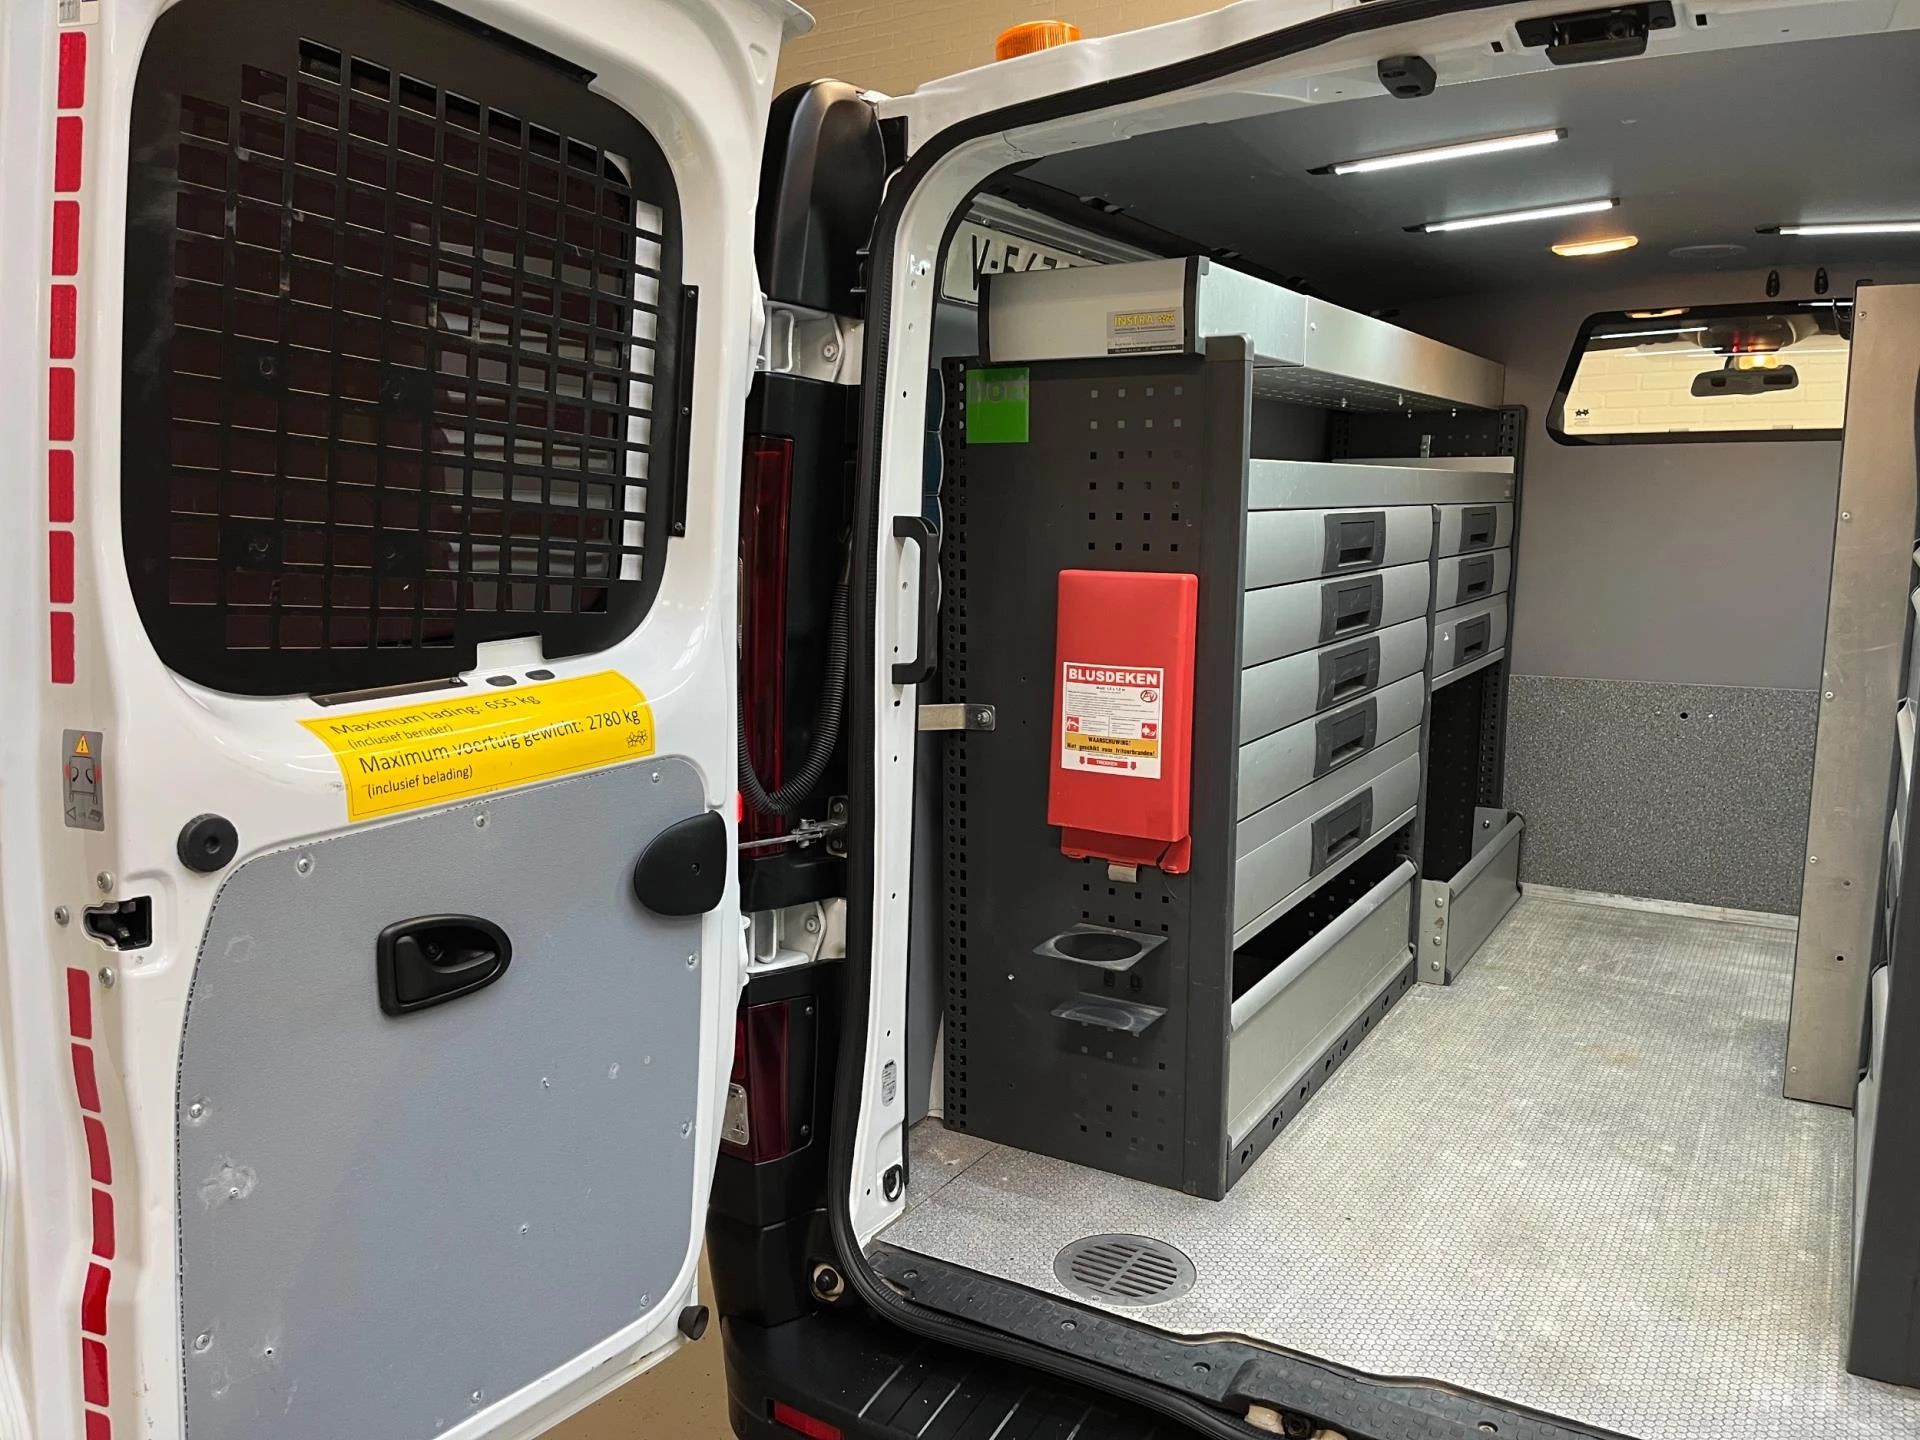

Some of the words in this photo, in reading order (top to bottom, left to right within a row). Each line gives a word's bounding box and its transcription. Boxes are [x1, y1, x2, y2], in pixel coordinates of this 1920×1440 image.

[1114, 314, 1153, 326] INSTRA
[1069, 668, 1157, 685] BLUSDEKEN
[330, 713, 422, 735] Maximum
[422, 704, 484, 721] lading:
[485, 697, 516, 710] 655
[516, 695, 541, 705] kg
[347, 731, 404, 750] (inclusief
[404, 724, 453, 739] berijder)
[359, 746, 450, 774] Maximum
[453, 731, 521, 757] voertuig
[524, 720, 584, 746] gewicht:
[586, 711, 621, 731] 2780
[622, 708, 641, 725] kg
[367, 775, 420, 799] (inclusief
[423, 764, 473, 784] belading)
